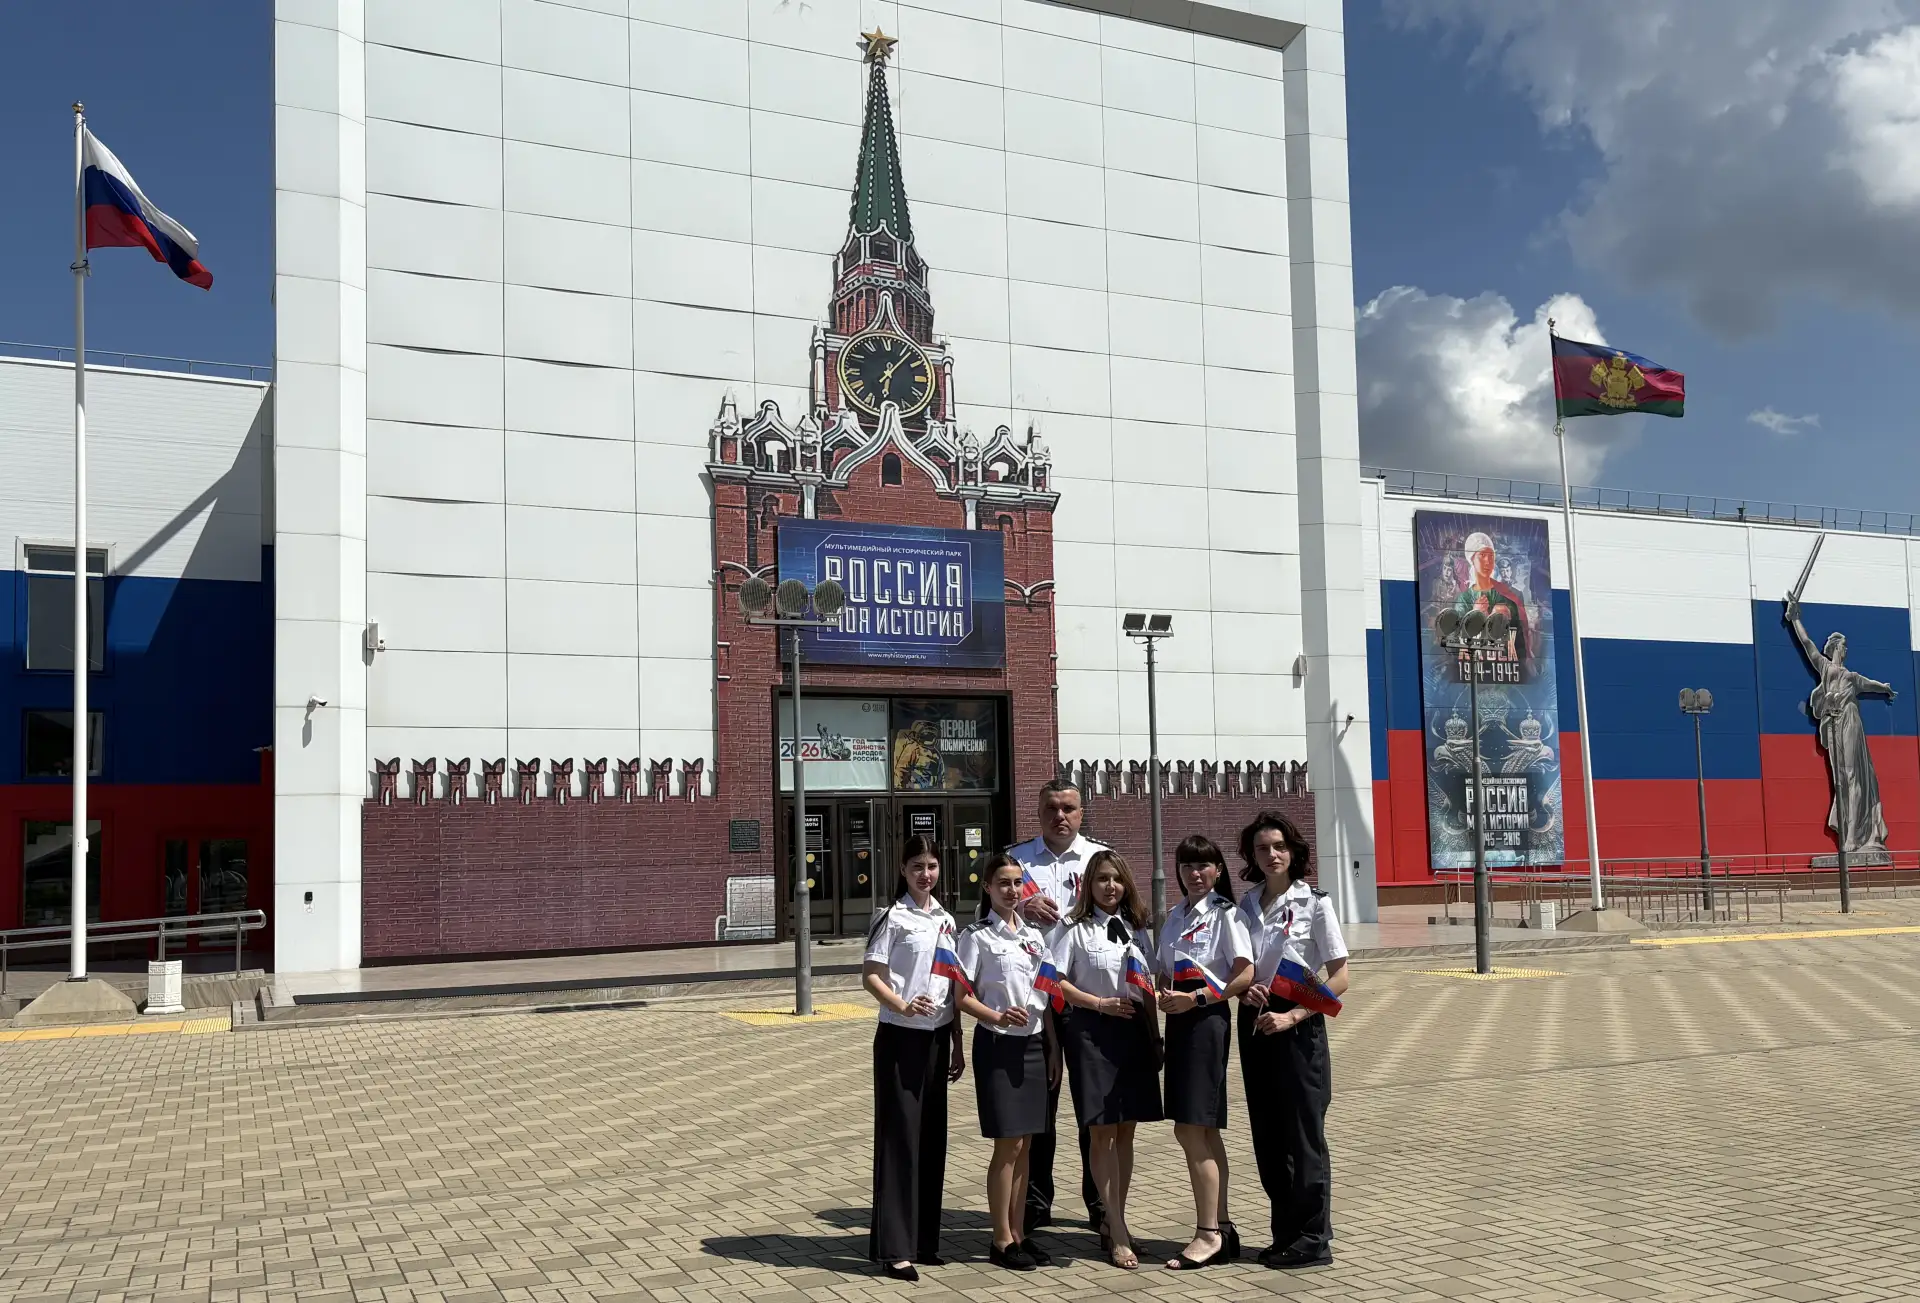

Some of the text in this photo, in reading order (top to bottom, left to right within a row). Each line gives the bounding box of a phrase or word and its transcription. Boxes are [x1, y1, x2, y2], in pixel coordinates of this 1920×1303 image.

[824, 543, 892, 554] МУЛЬТИМЕДИЙНЫЙ
[893, 547, 944, 556] ИСТОРИЧЕСКИЙ
[876, 607, 965, 637] ИСТОРИЯ
[867, 652, 927, 661] www.myhistorypark.ru
[1458, 661, 1520, 682] 194-1945
[940, 719, 977, 739] ПЕРВАЯ
